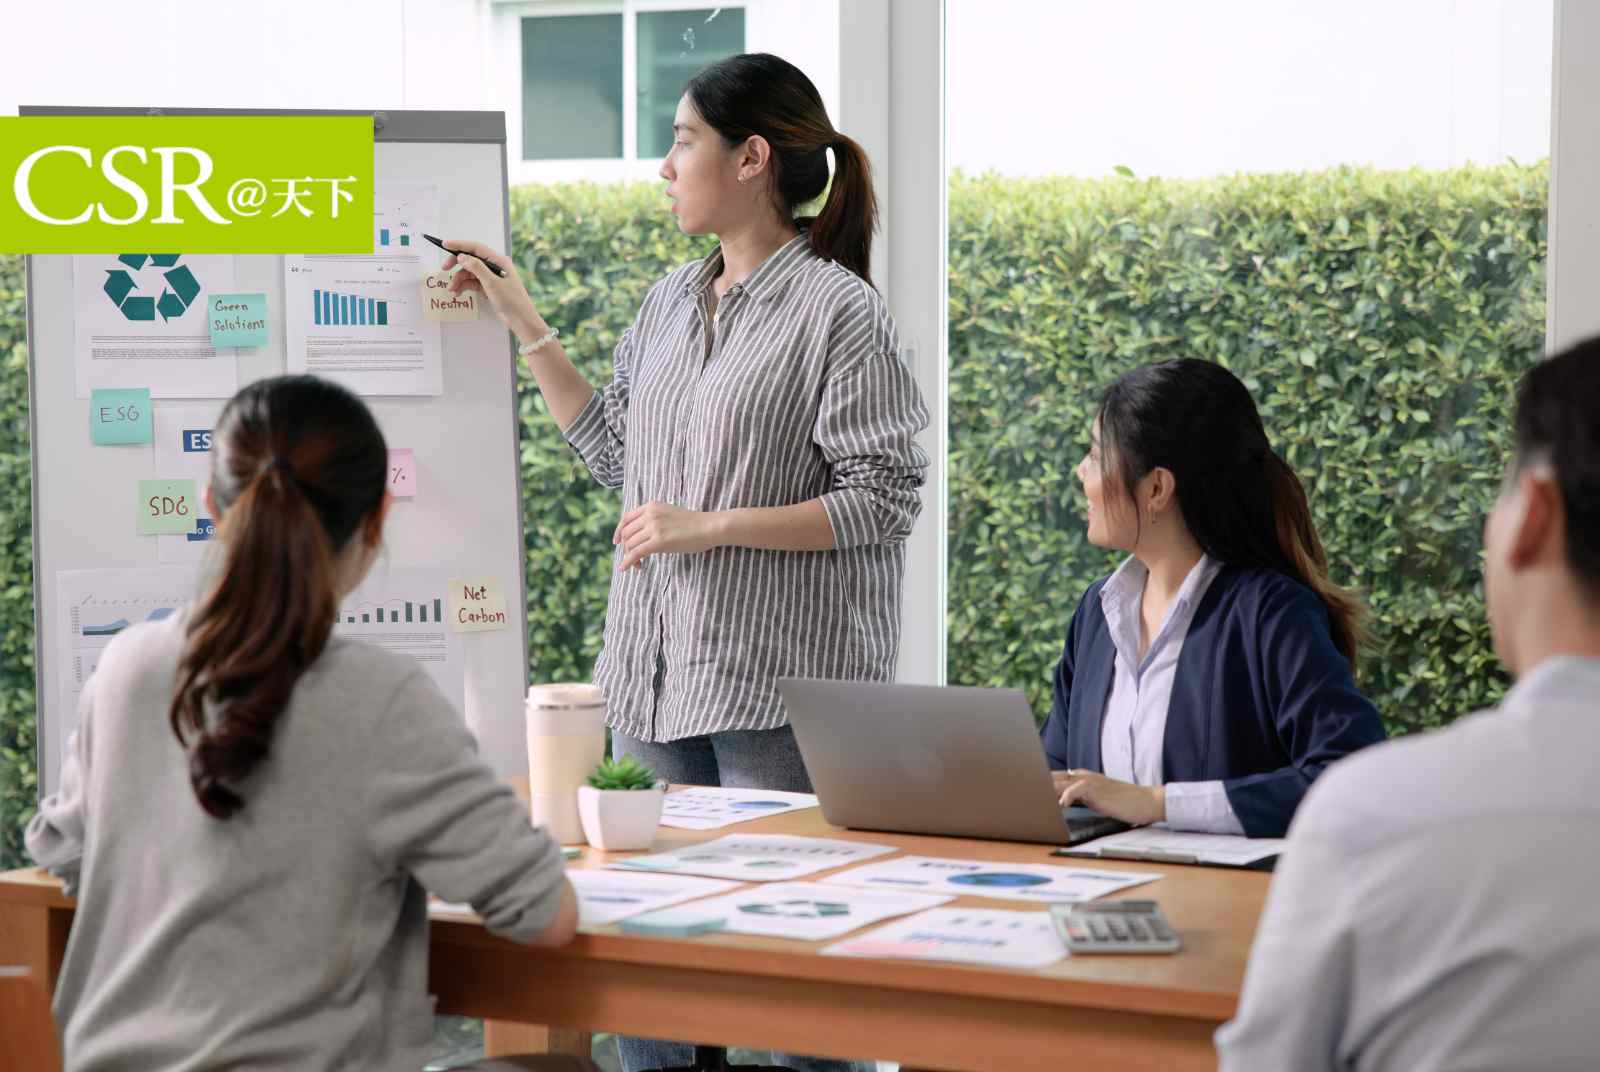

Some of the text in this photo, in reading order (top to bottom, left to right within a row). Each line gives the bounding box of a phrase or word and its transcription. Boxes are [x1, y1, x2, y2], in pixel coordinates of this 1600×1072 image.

[426, 275, 453, 289] Car
[214, 299, 249, 312] Green
[430, 295, 474, 310] Neutral
[99, 405, 140, 423] ESG
[191, 432, 213, 449] ES
[149, 495, 189, 516] SDG
[463, 584, 488, 601] Net
[458, 607, 506, 624] Carbon
